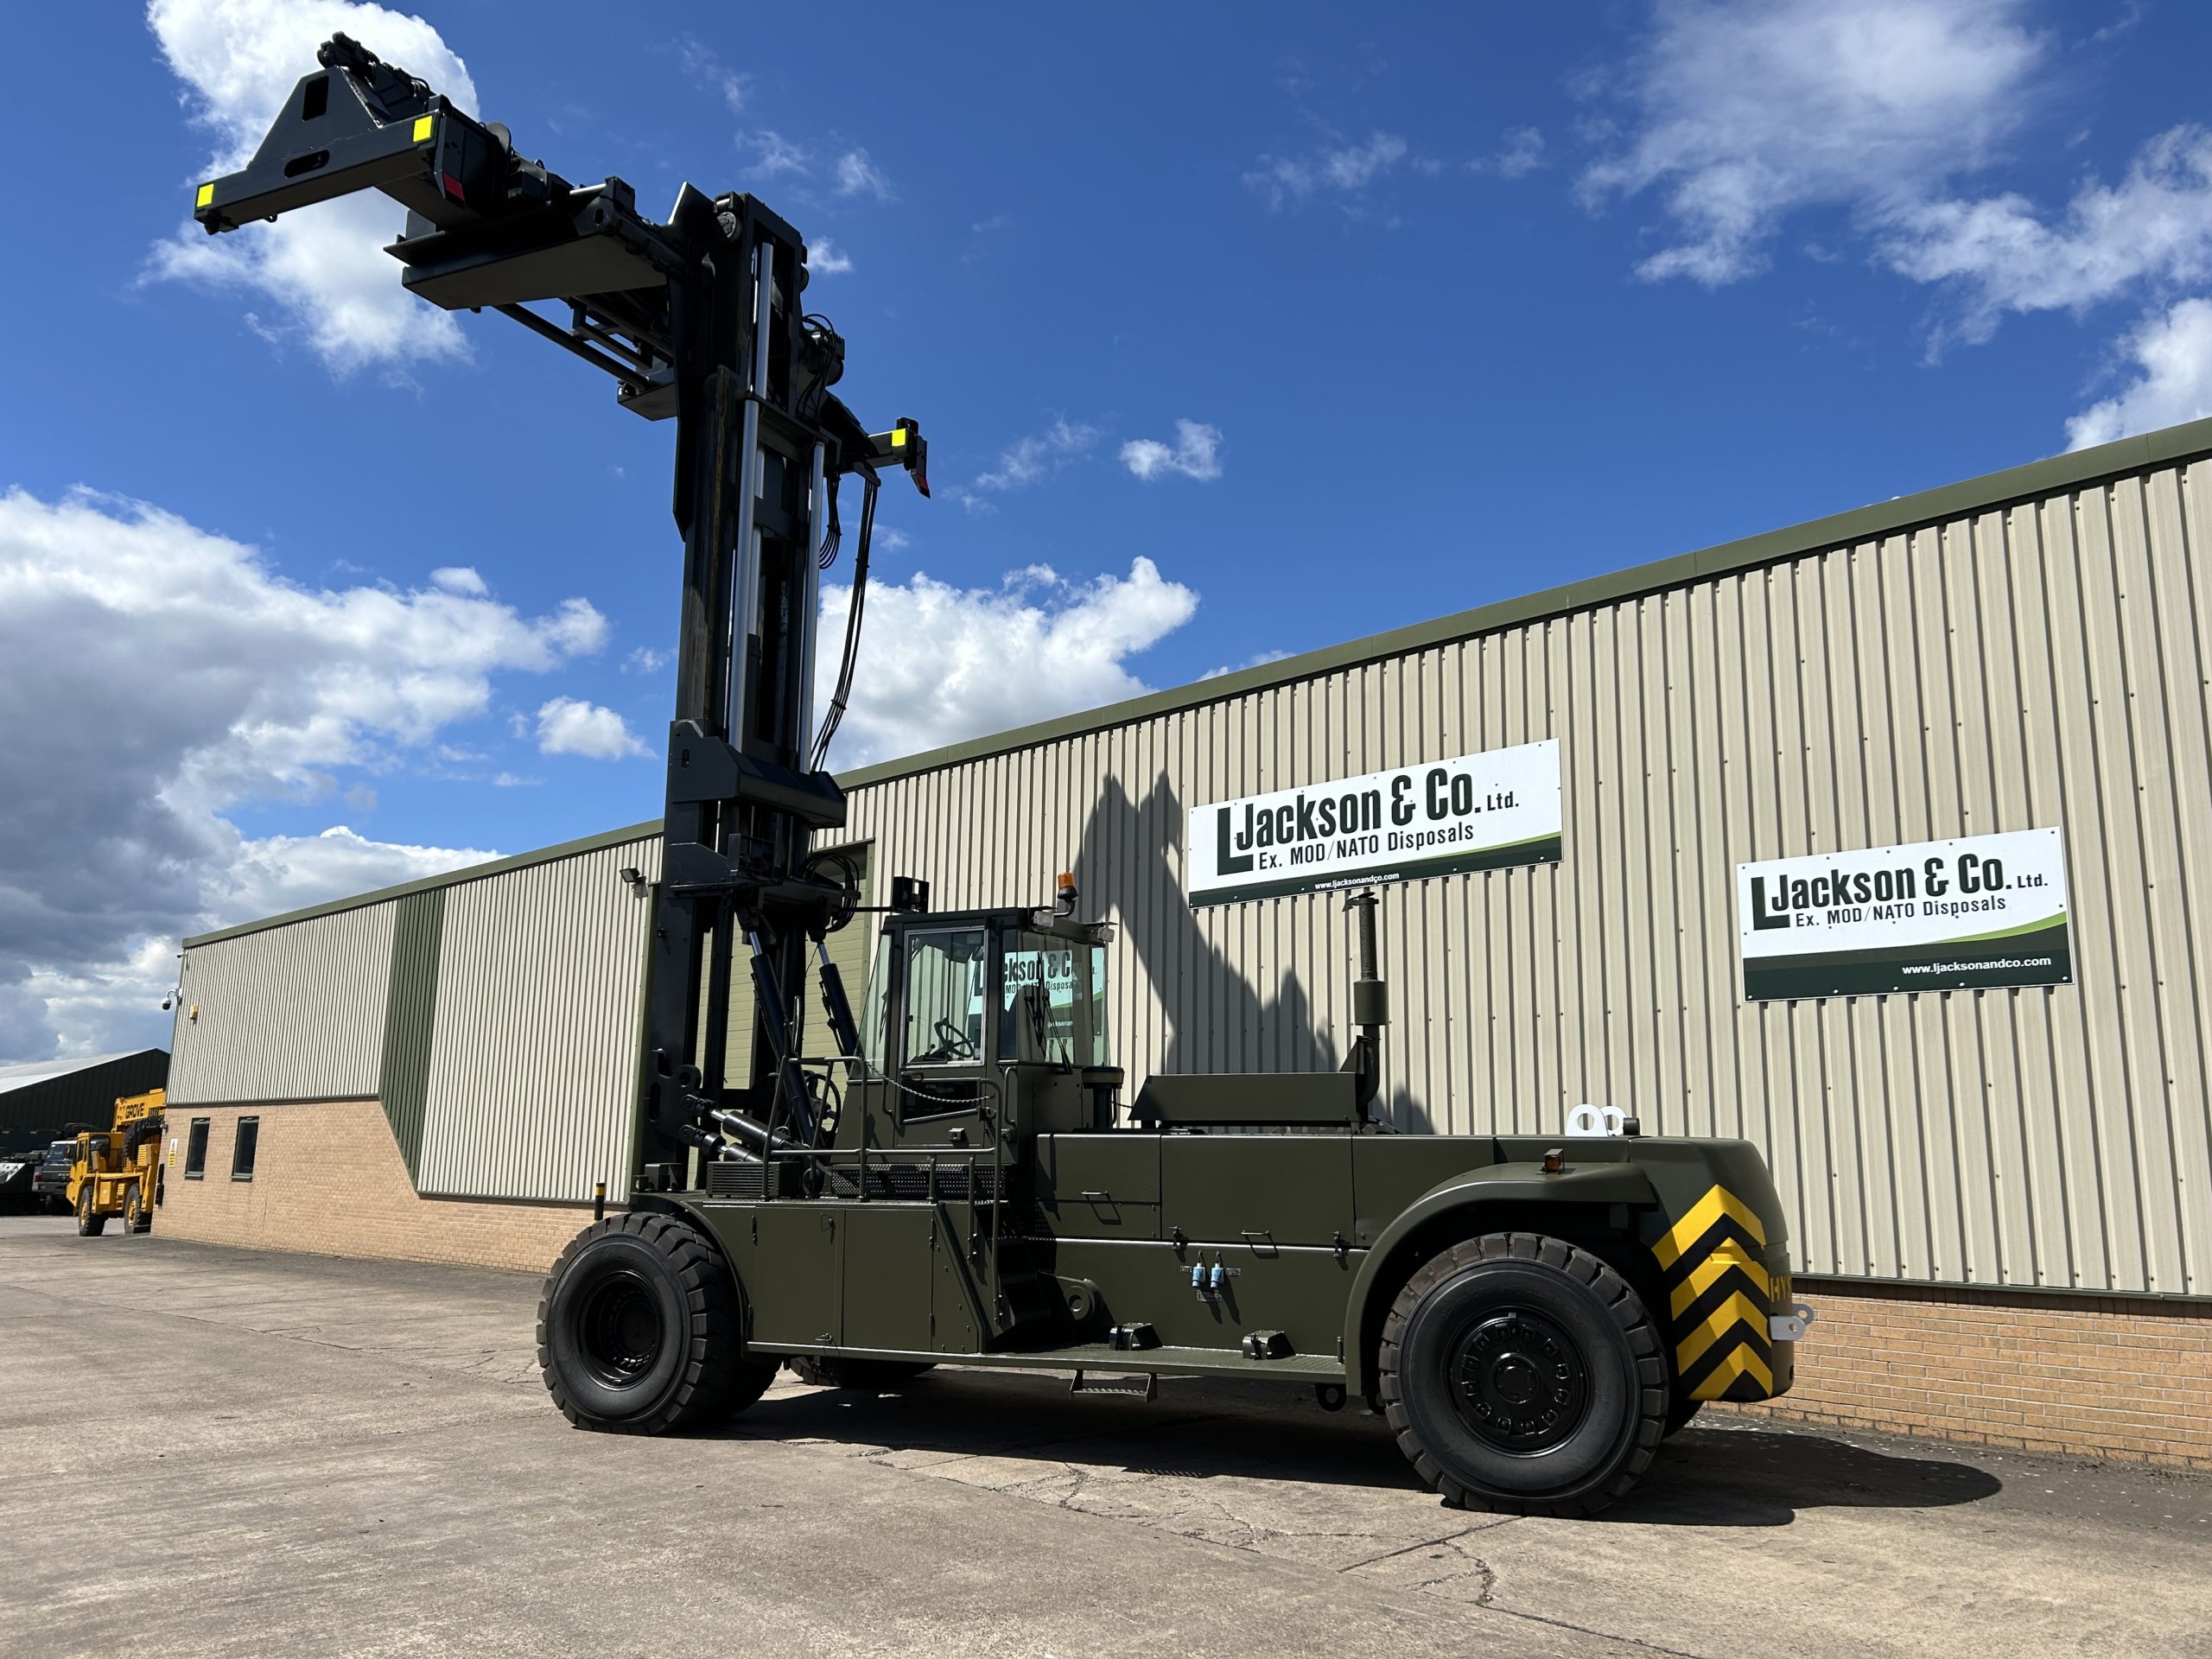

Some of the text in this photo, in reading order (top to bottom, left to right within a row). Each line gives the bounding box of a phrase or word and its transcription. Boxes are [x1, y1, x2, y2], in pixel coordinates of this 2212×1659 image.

[1391, 775, 1416, 826] &
[1426, 767, 1481, 821] Co.
[1487, 791, 1520, 812] Ltd.
[1259, 822, 1474, 870] Ex. MOD/NATO Disposals
[1315, 871, 1400, 890] www.ljacksonandco.com
[1924, 857, 1949, 897] &
[1957, 854, 2012, 893] Co.
[2017, 874, 2049, 889] Ltd.
[1796, 895, 2006, 927] Ex. MOD/NATO Disposals
[1902, 956, 2051, 976] www.ljacksonandco.com
[125, 1103, 144, 1120] GROVE
